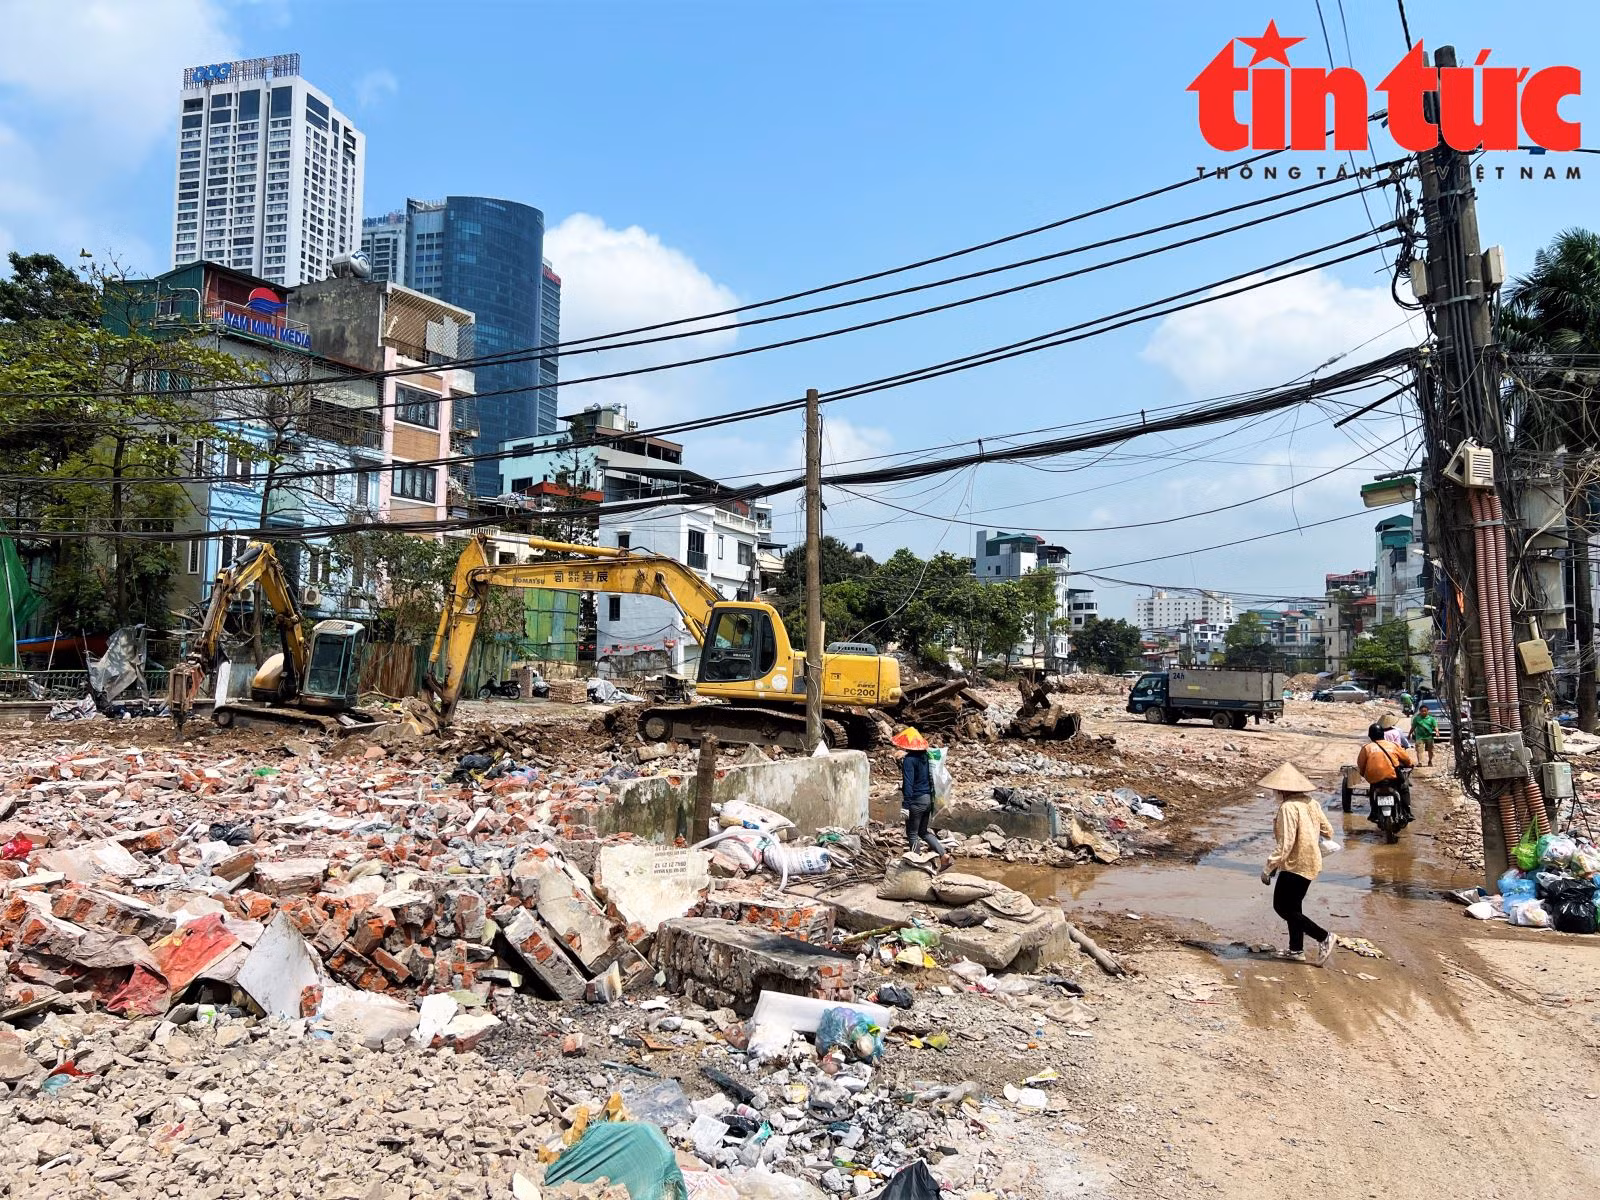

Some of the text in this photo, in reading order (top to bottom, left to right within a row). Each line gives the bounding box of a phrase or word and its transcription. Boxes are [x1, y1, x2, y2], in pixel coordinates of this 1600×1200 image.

[197, 67, 227, 79] FLC
[224, 311, 311, 348] NAM MINH MEDIA
[1172, 672, 1185, 680] 24h
[843, 688, 876, 697] PC200
